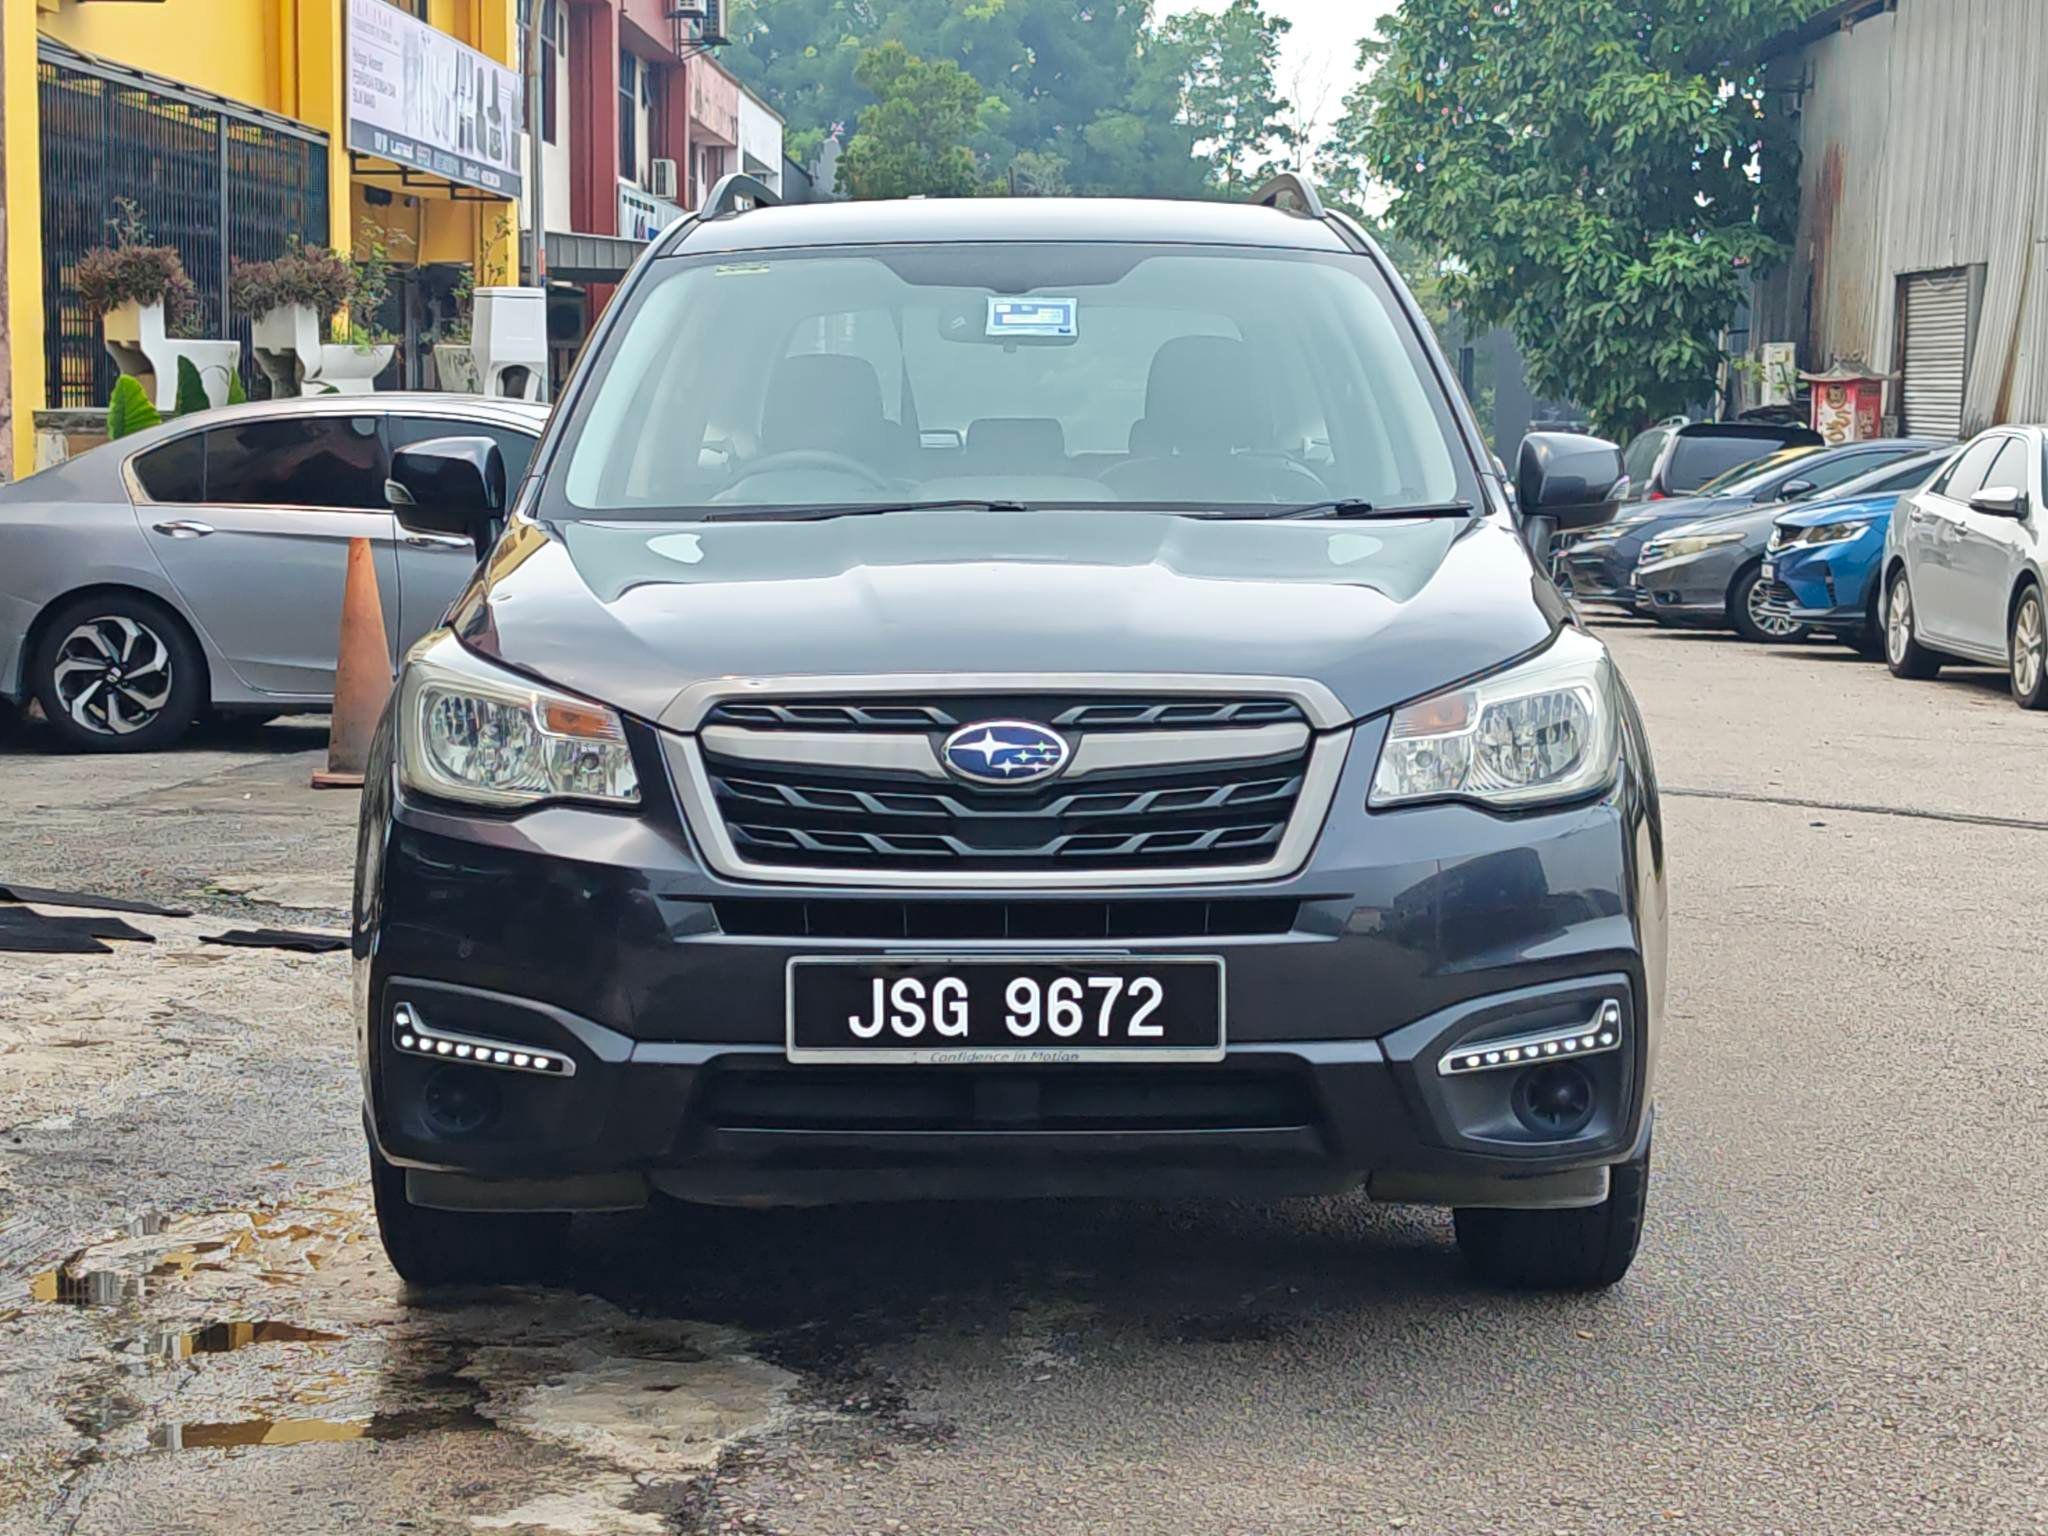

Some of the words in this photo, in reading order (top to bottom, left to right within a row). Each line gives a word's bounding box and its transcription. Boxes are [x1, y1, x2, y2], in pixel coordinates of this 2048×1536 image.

[848, 976, 969, 1038] JSG
[1004, 976, 1165, 1037] 9672
[930, 1051, 1010, 1063] Confidence
[1013, 1051, 1026, 1062] in
[1030, 1050, 1080, 1062] Motion
